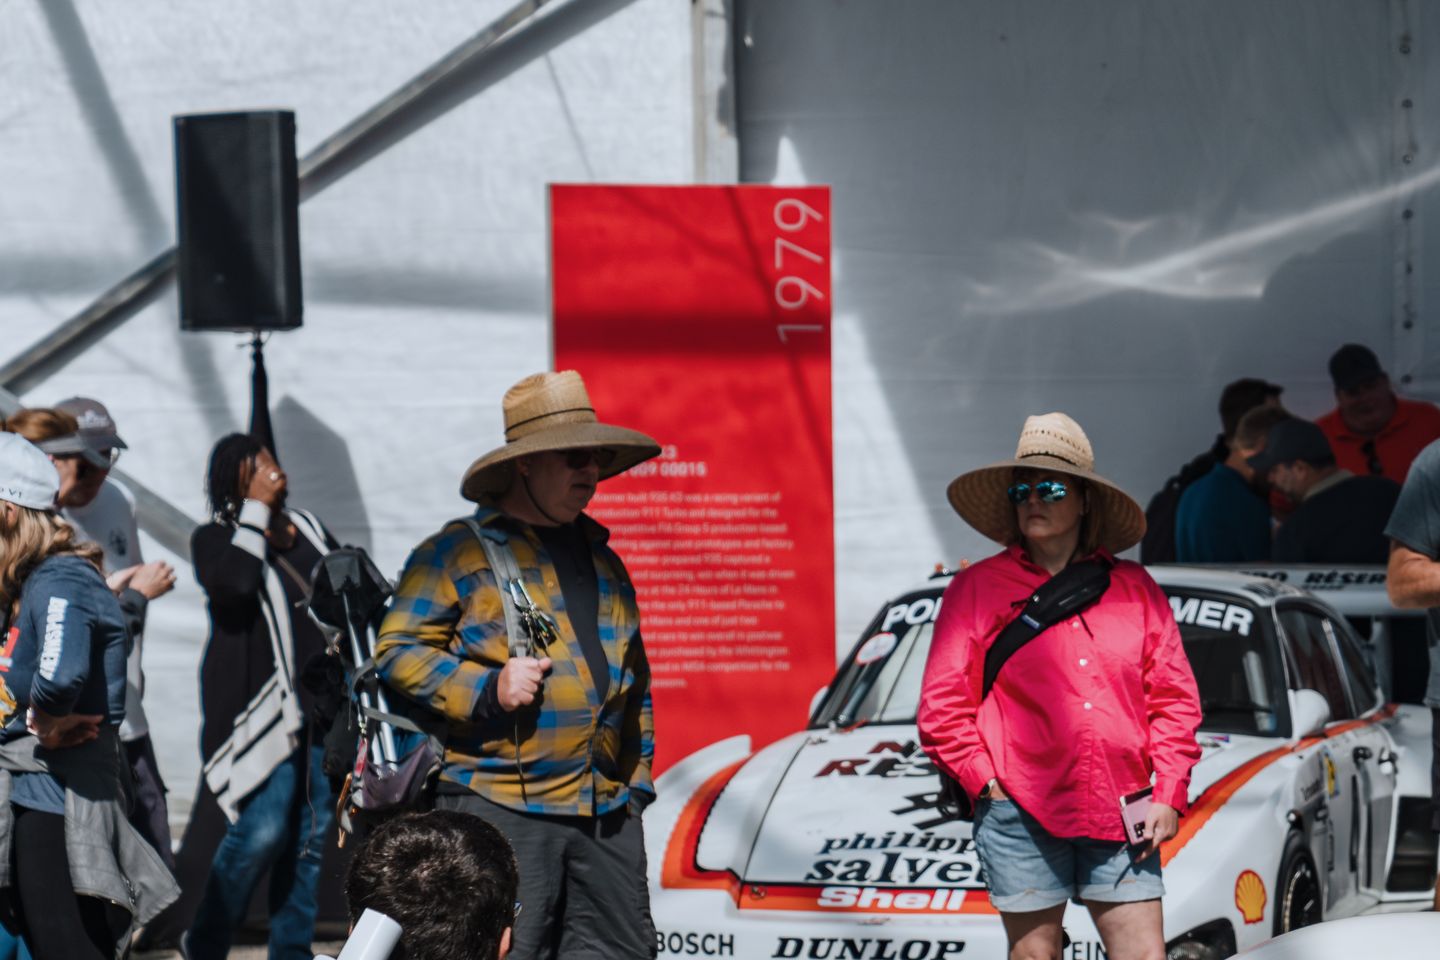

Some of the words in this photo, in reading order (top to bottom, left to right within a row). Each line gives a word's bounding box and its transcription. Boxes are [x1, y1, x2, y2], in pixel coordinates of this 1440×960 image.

[774, 197, 825, 345] 1979
[816, 886, 968, 911] Shell
[656, 931, 735, 956] BOSCH
